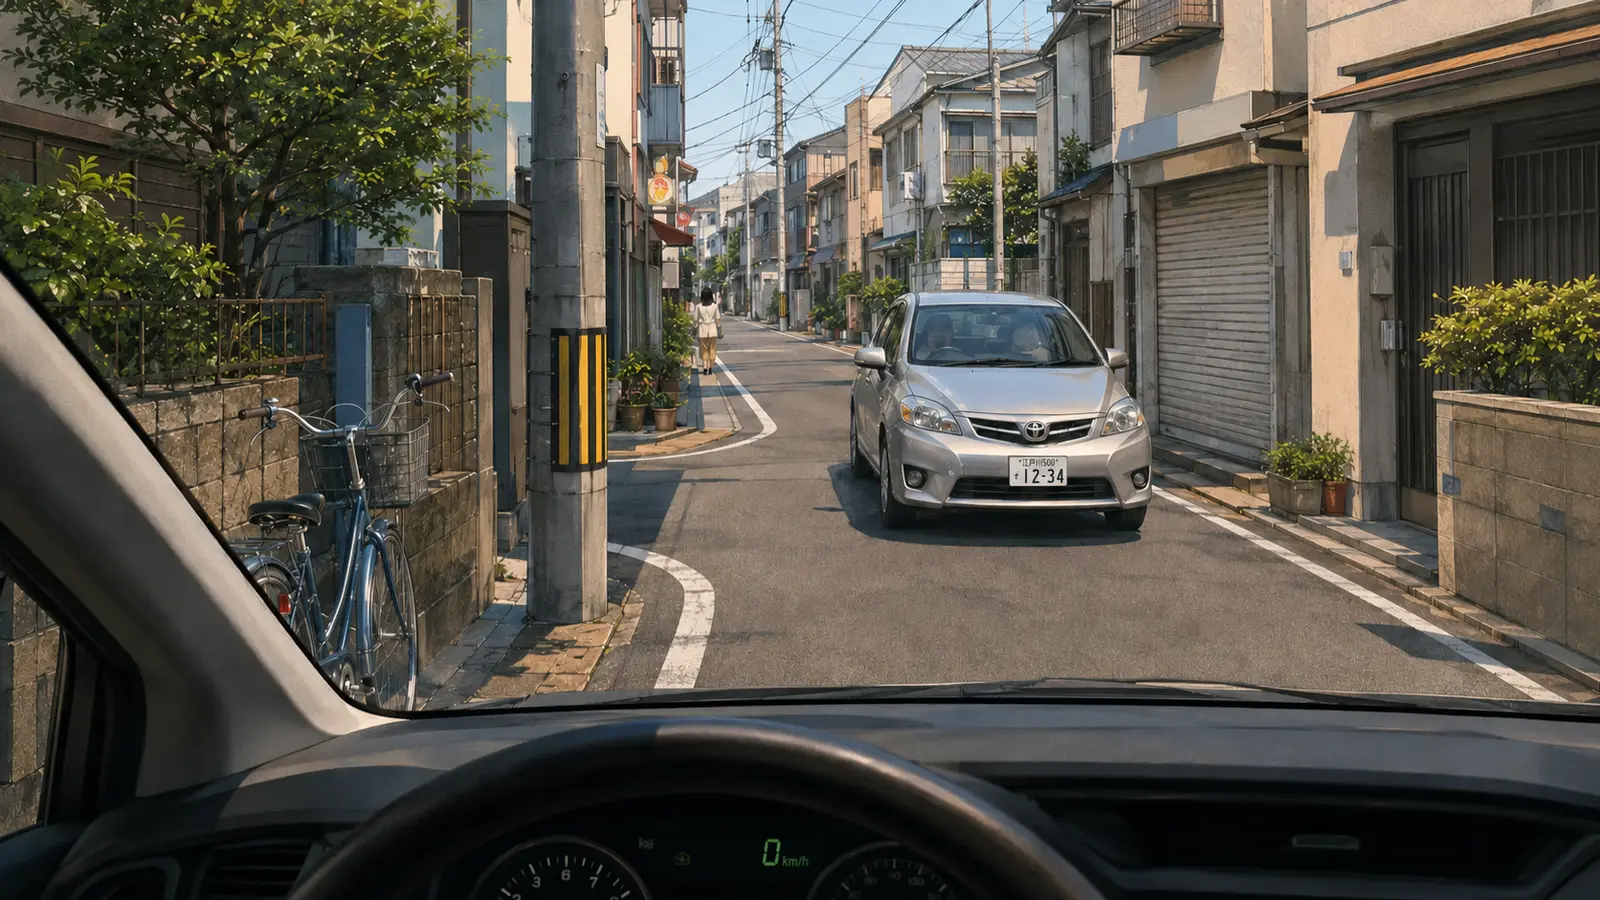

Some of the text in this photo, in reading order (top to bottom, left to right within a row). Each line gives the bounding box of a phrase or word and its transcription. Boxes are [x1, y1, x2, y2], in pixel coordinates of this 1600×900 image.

[1024, 468, 1064, 484] 12-34
[762, 838, 809, 867] 0 km/h
[561, 869, 571, 881] 6
[532, 876, 541, 888] 3
[589, 876, 599, 889] 7
